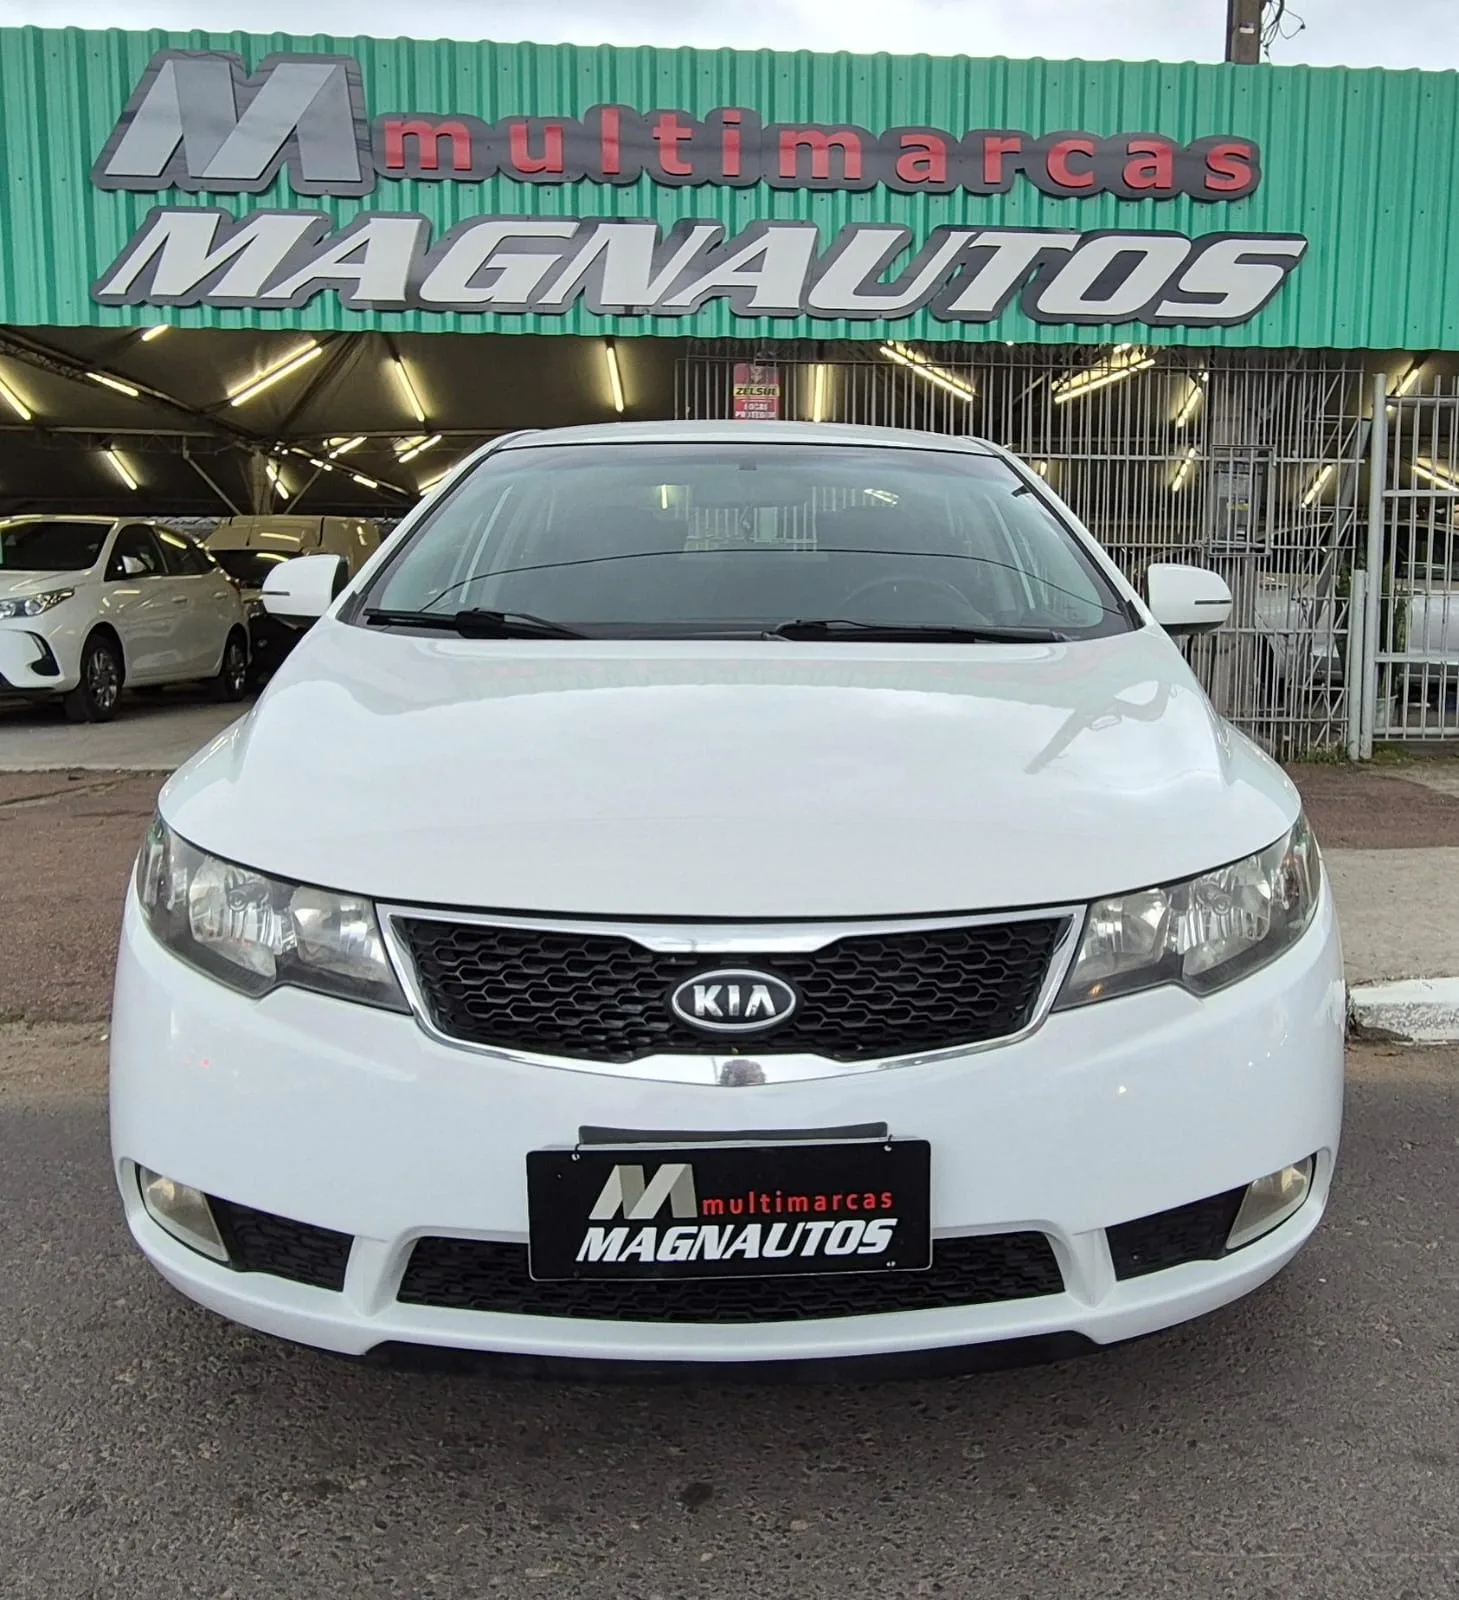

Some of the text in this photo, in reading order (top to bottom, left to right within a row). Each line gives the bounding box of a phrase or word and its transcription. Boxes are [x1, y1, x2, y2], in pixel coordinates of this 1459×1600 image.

[105, 58, 1255, 193] M multimarcas
[97, 211, 1308, 319] MAGNAUTOS
[693, 984, 776, 1017] KIA
[588, 1163, 893, 1220] M multimarcas
[575, 1218, 898, 1262] MAGNAUTOS
